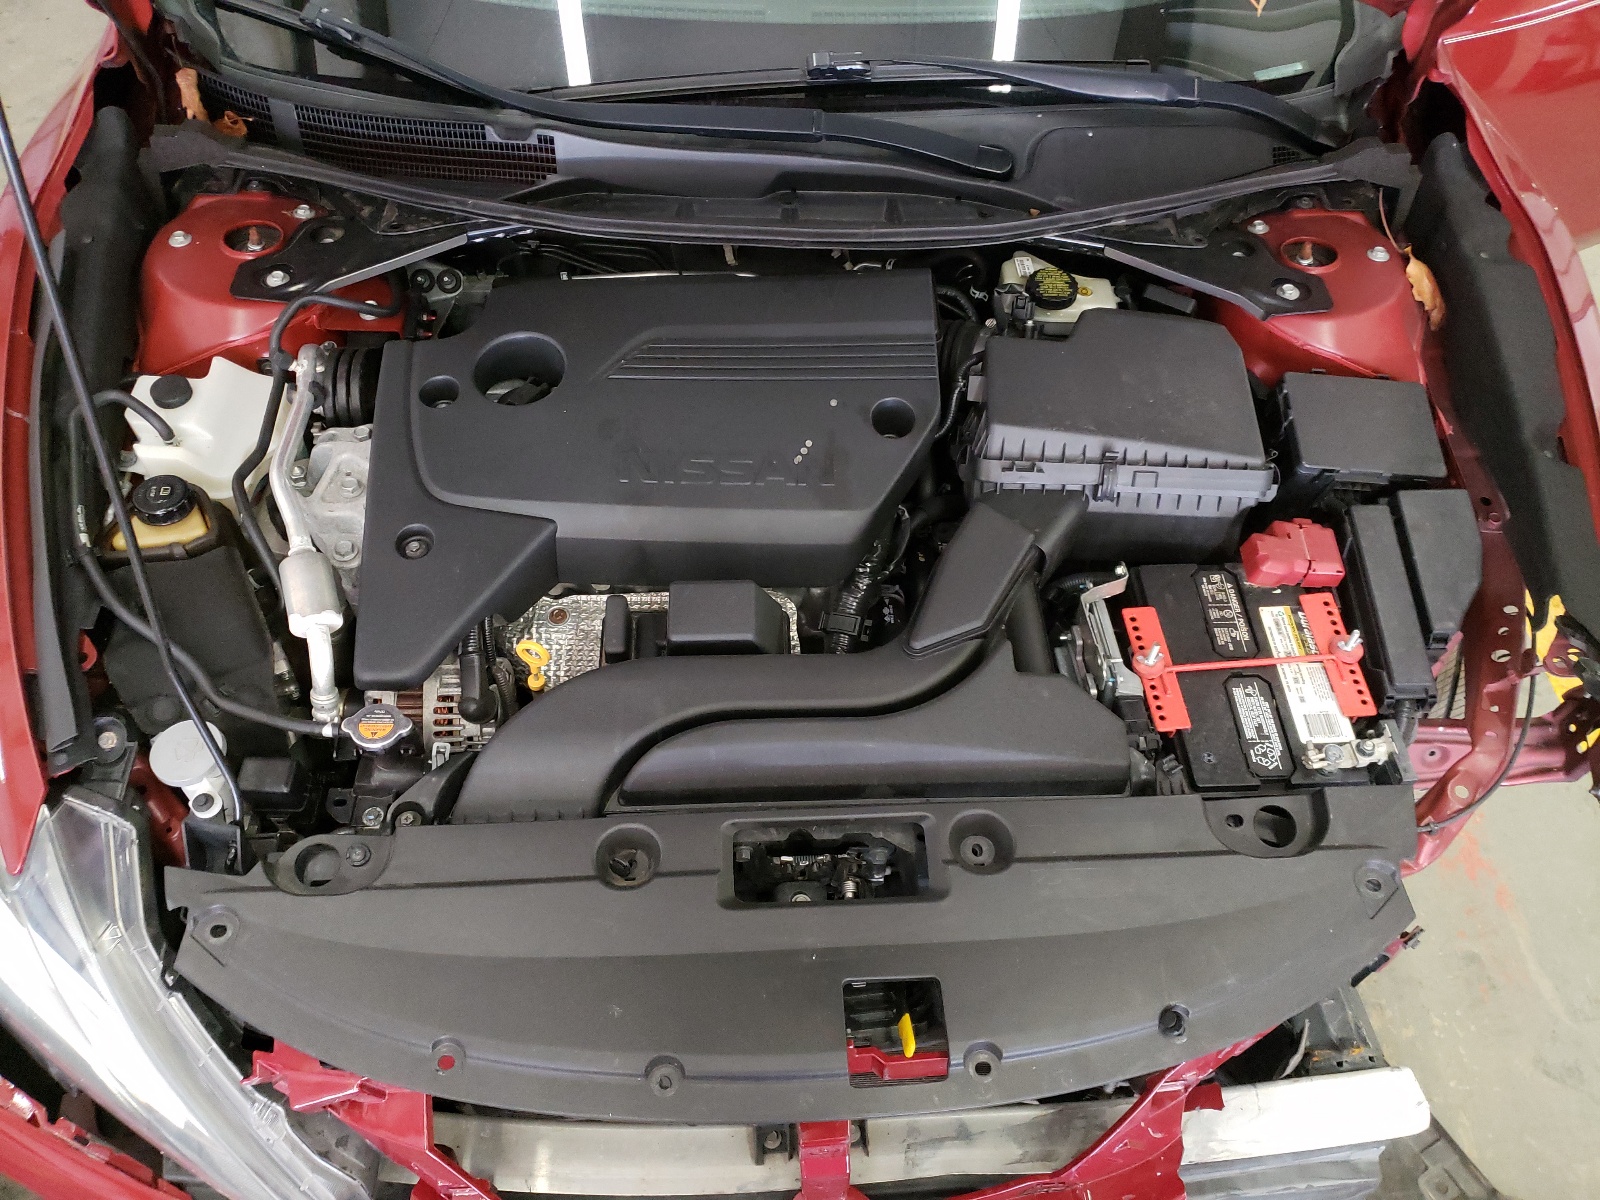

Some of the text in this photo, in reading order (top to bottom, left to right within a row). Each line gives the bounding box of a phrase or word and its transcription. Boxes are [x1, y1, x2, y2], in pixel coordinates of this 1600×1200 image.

[618, 446, 836, 487] NISSAN
[1228, 588, 1241, 613] DANGER
[1238, 618, 1250, 641] POISON
